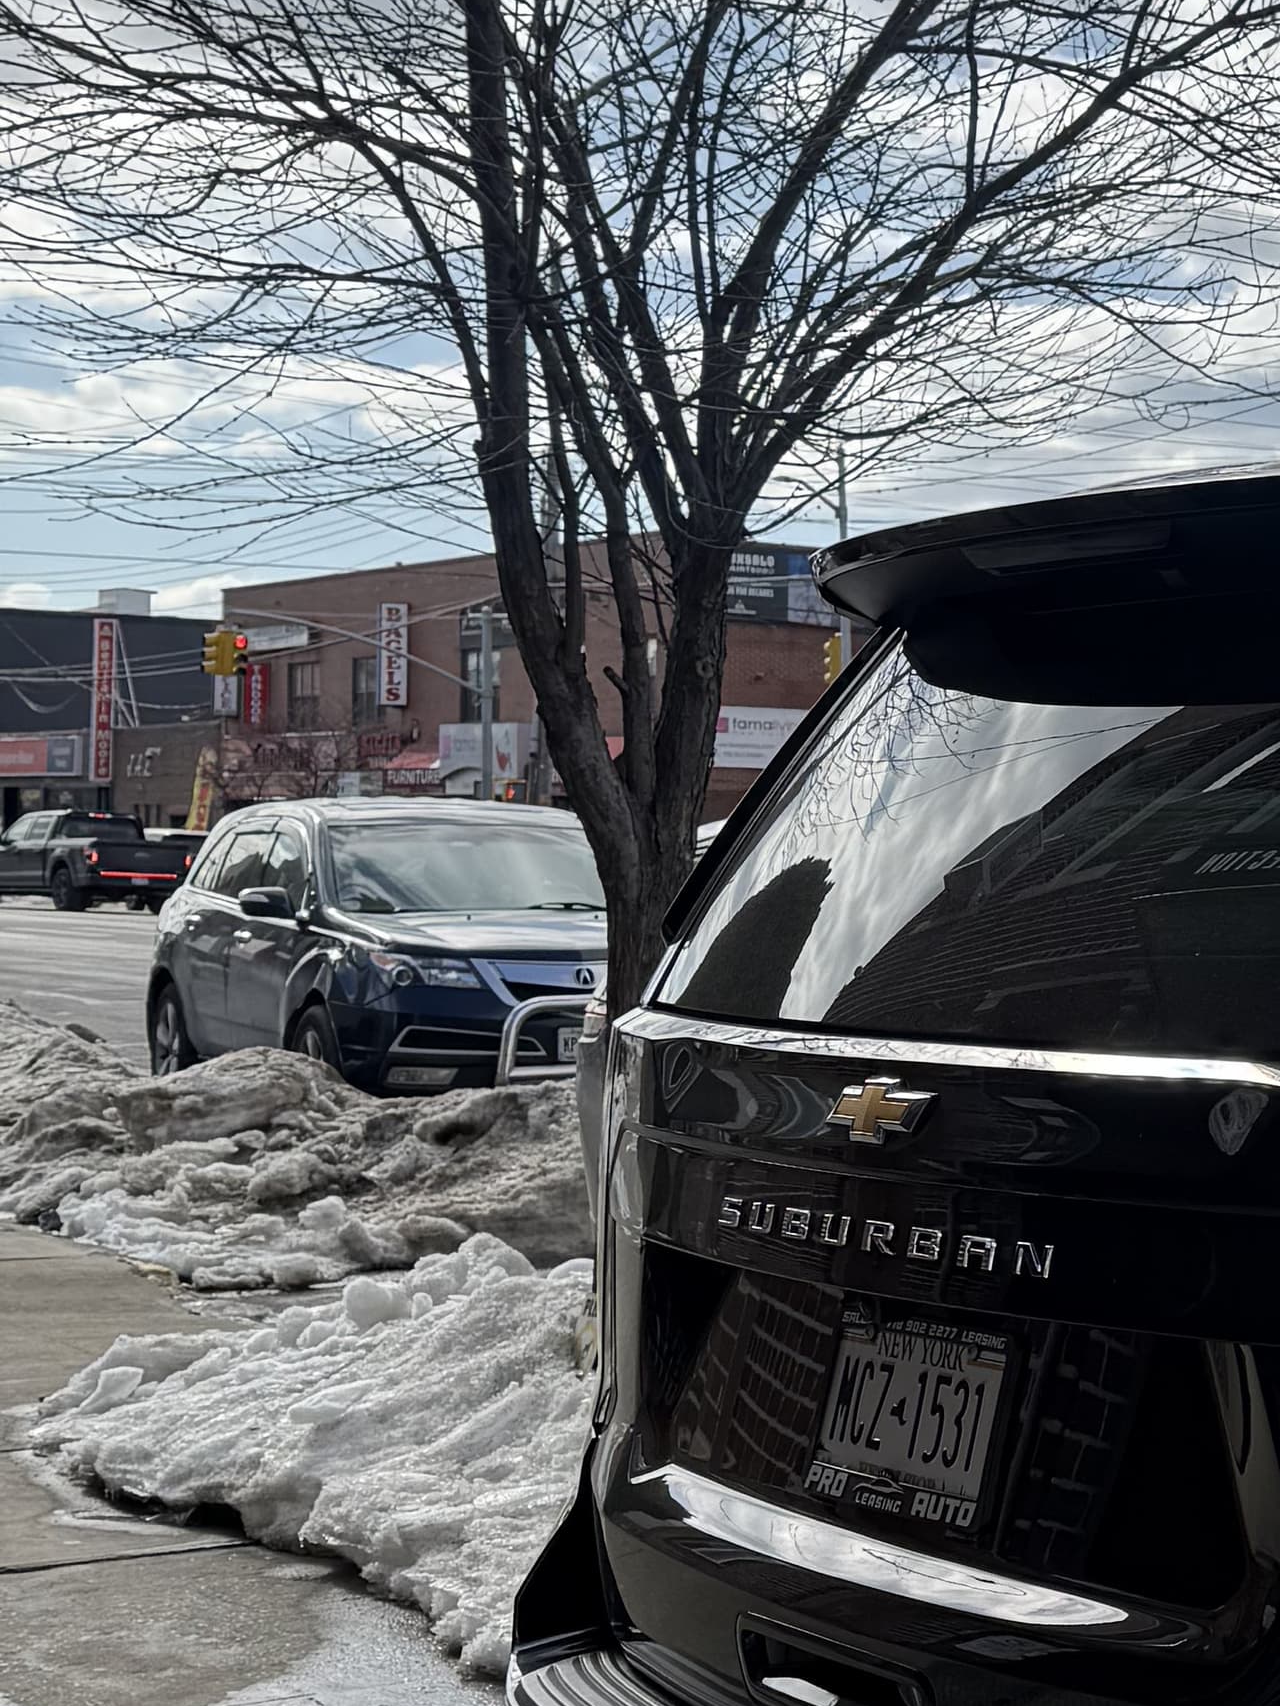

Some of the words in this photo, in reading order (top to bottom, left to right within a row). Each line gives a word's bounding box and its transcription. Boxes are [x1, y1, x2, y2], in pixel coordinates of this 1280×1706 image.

[385, 606, 402, 702] BAGELS
[386, 769, 441, 784] FURNITURE
[718, 1196, 1055, 1279] SUBURBAN
[877, 1332, 917, 1361] NEW
[919, 1337, 966, 1372] YORK
[904, 1319, 928, 1334] 902
[928, 1325, 959, 1340] 2277
[960, 1330, 1009, 1350] LEASING
[803, 1464, 850, 1498] PRO
[909, 1491, 978, 1528] AUTO
[854, 1492, 902, 1514] LEASING
